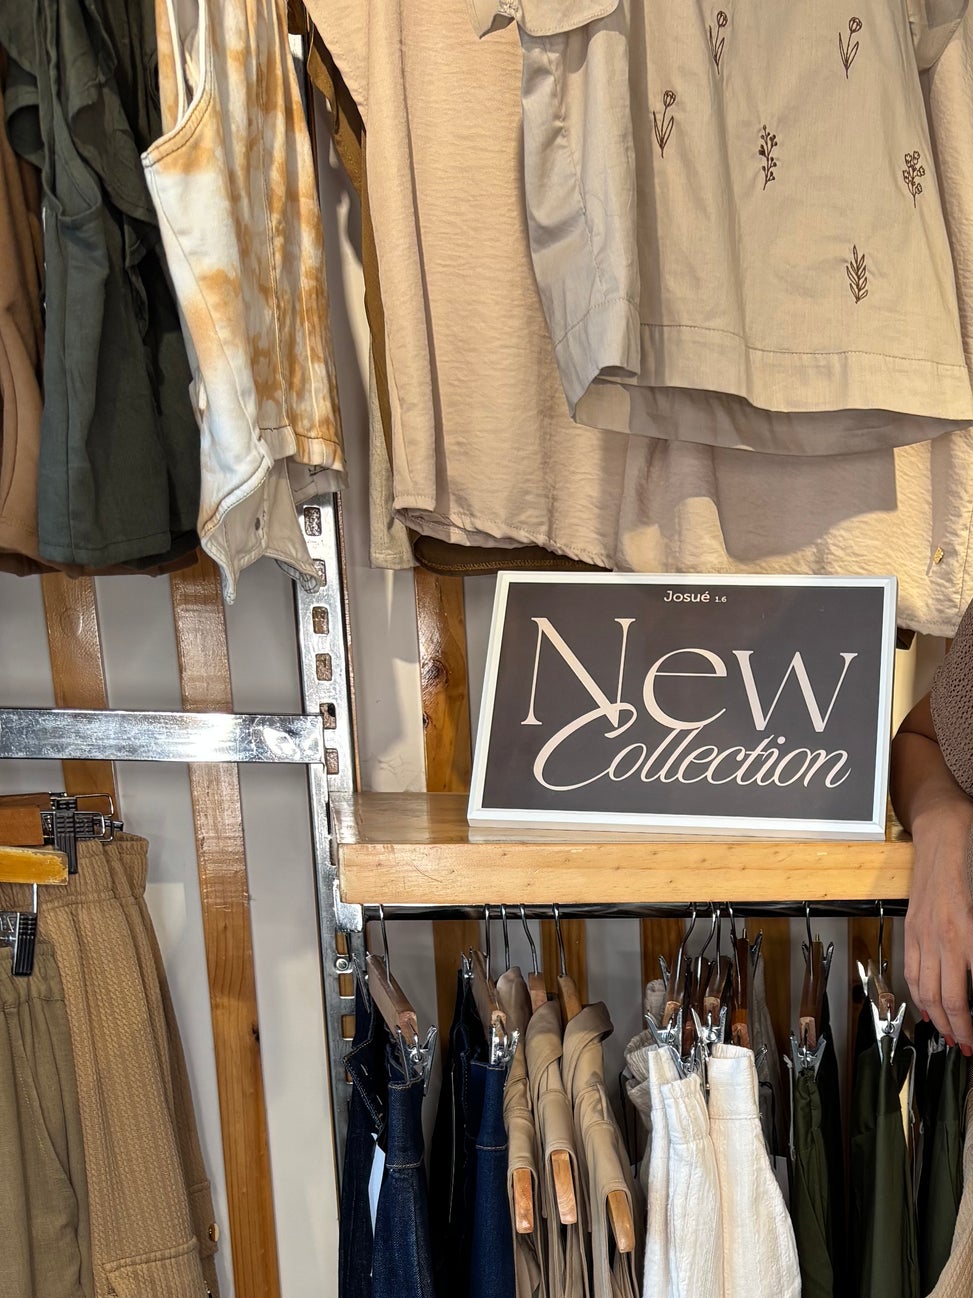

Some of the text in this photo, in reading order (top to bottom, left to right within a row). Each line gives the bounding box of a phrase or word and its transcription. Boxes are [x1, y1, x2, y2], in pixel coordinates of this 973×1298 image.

[664, 590, 727, 604] Josué 1.6
[521, 617, 859, 733] New
[533, 702, 851, 792] Collection
